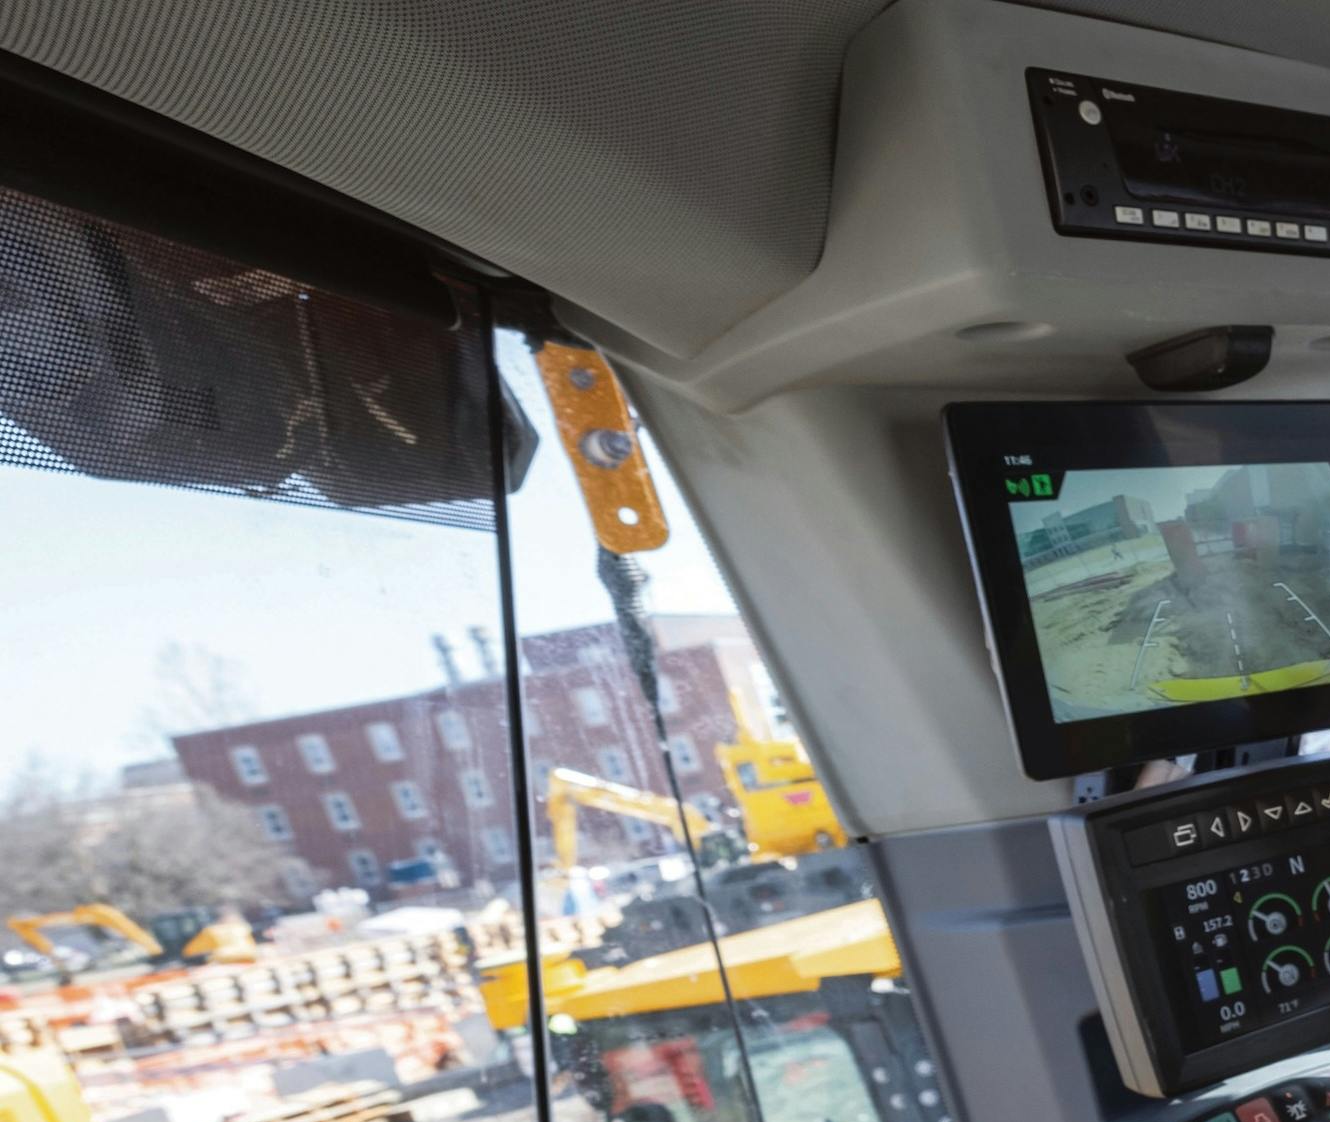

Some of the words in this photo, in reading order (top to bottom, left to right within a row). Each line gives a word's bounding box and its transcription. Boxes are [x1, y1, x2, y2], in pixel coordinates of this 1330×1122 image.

[1239, 868, 1251, 882] 2
[1288, 855, 1306, 876] N
[1186, 879, 1217, 900] 800
[1203, 914, 1233, 933] 157.2
[1219, 1001, 1246, 1021] 0.0
